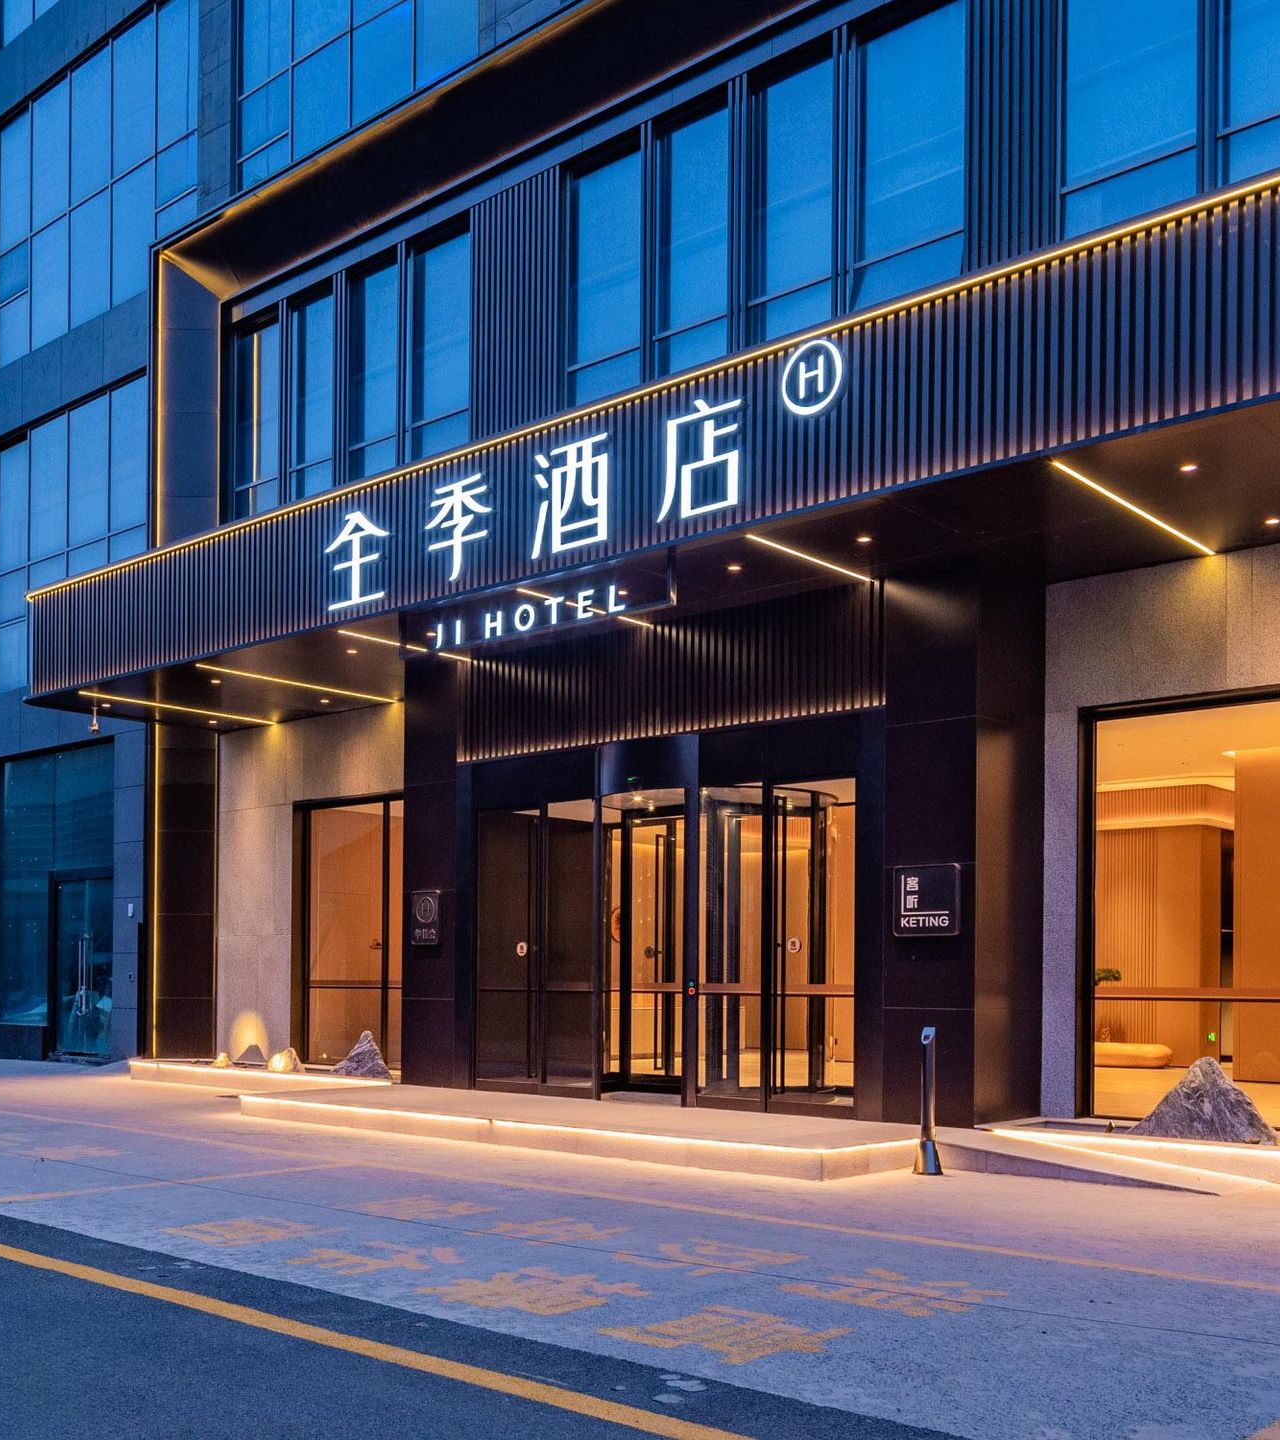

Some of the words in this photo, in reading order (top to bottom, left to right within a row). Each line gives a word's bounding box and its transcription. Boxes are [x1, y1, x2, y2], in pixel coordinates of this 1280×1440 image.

[323, 396, 743, 613] 全季酒店
[434, 607, 462, 650] JI
[484, 583, 627, 640] HOTEL
[900, 916, 950, 928] KETING
